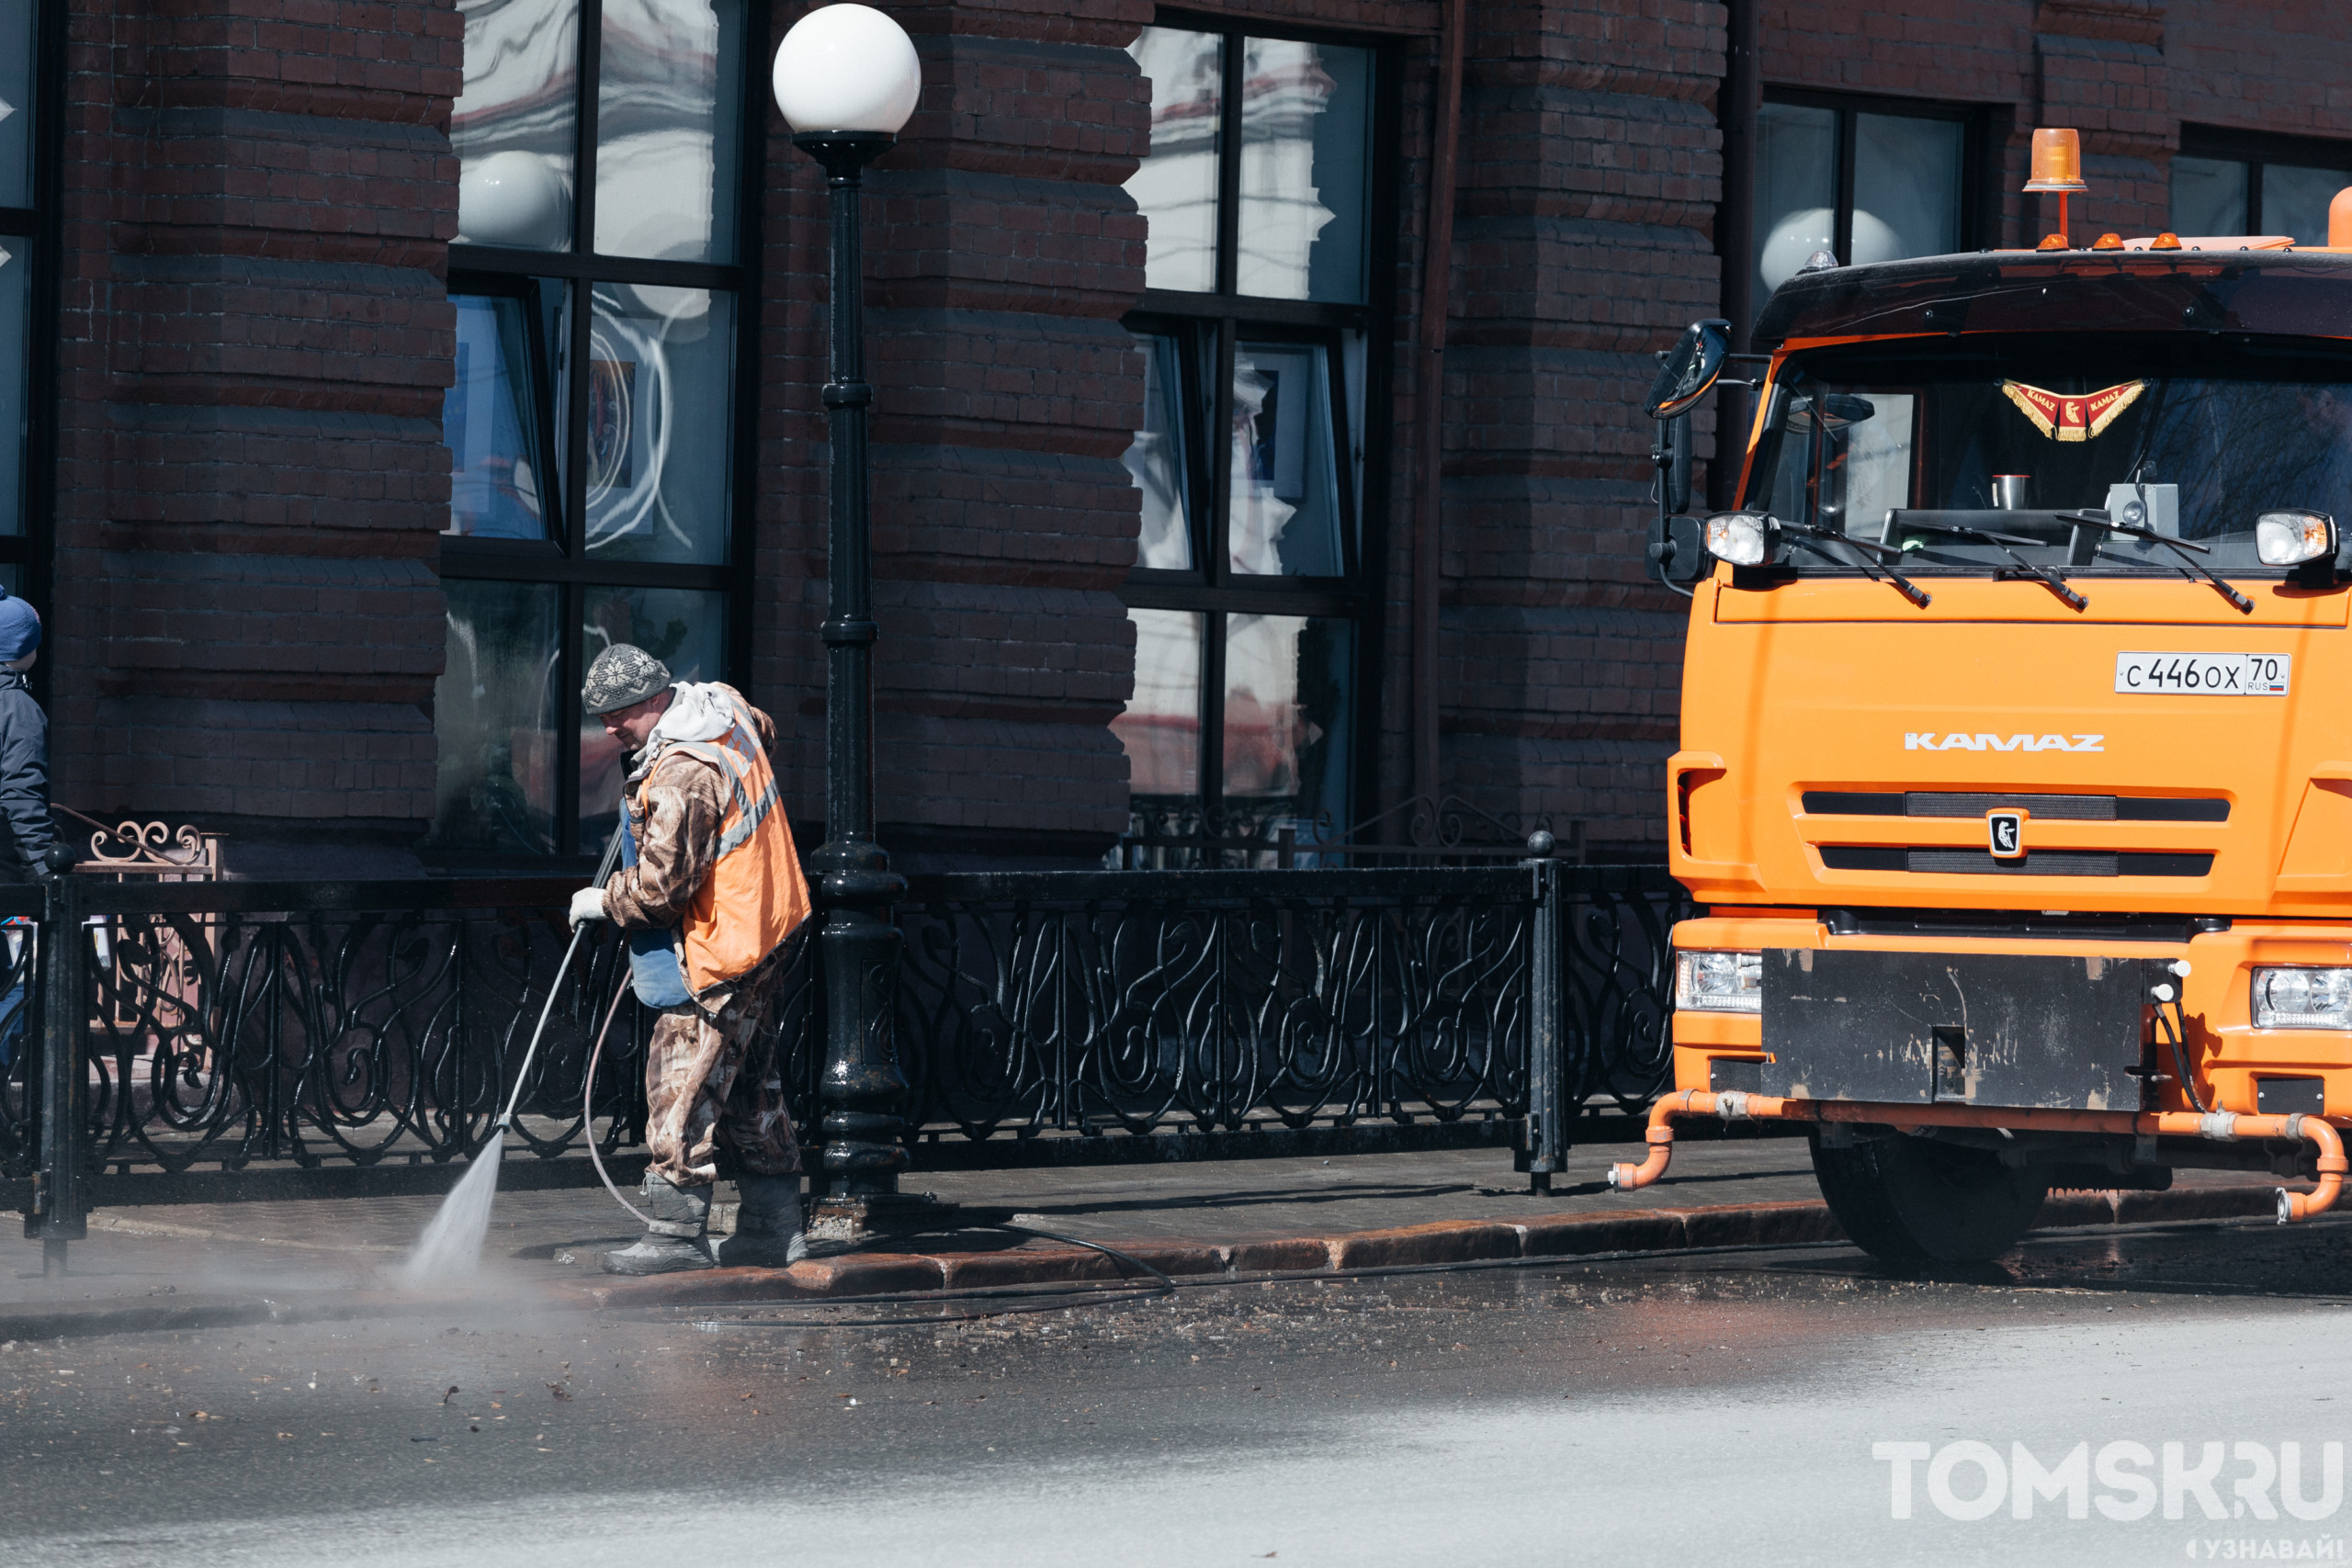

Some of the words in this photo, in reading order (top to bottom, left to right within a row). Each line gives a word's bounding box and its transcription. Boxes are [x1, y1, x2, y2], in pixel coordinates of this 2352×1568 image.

[2027, 389, 2055, 412] KAMAZ
[2090, 390, 2120, 412] KAMAZ
[2251, 659, 2278, 681] 70
[1905, 732, 2104, 751] KAMAZ
